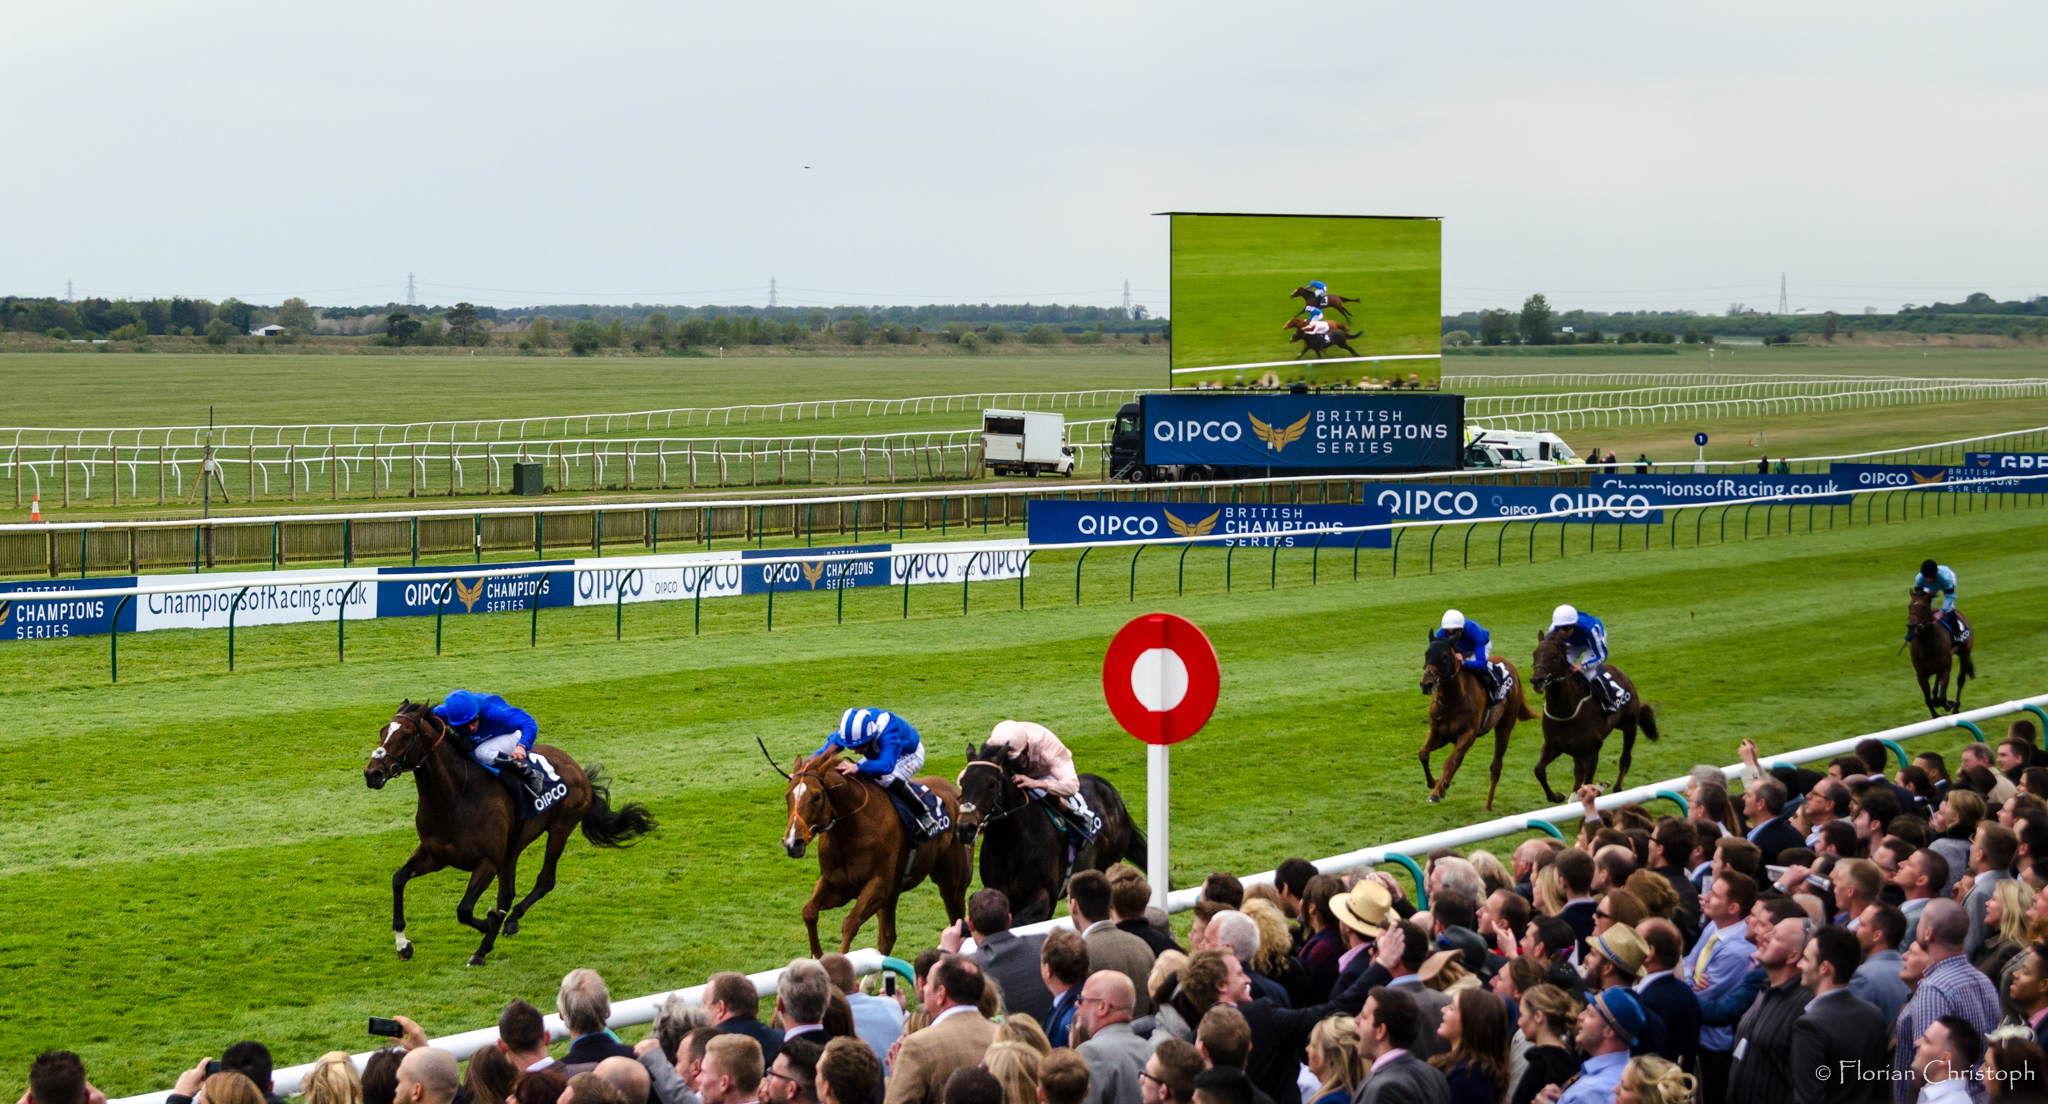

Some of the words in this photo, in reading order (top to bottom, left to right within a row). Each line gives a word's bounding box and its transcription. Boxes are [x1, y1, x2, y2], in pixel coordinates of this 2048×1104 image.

[1317, 410, 1402, 422] BRITISH
[1153, 420, 1242, 443] QIPCO
[1316, 424, 1448, 440] CHAMPIONS
[1698, 435, 1703, 443] 1
[1316, 442, 1393, 454] SERIES
[1859, 472, 1908, 486] QIPCO
[1948, 468, 1996, 476] BRITISH
[1377, 489, 1479, 516] QIPCO
[1500, 505, 1538, 516] QIPCO
[1550, 493, 1650, 518] QIPCO
[1225, 507, 1303, 519] BRITISH
[1078, 515, 1159, 536] QIPCO
[1225, 520, 1344, 535] CHAMPIONS
[1225, 536, 1295, 547] SERIES
[763, 562, 800, 584] QIPCO
[826, 561, 874, 577] CHAMPIONS
[578, 569, 644, 601] QIPCO
[405, 582, 453, 607] QIPCO
[16, 601, 104, 623] CHAMPIONS
[487, 600, 524, 613] SERIES
[16, 624, 69, 640] SERIES
[534, 783, 568, 811] QIPCO
